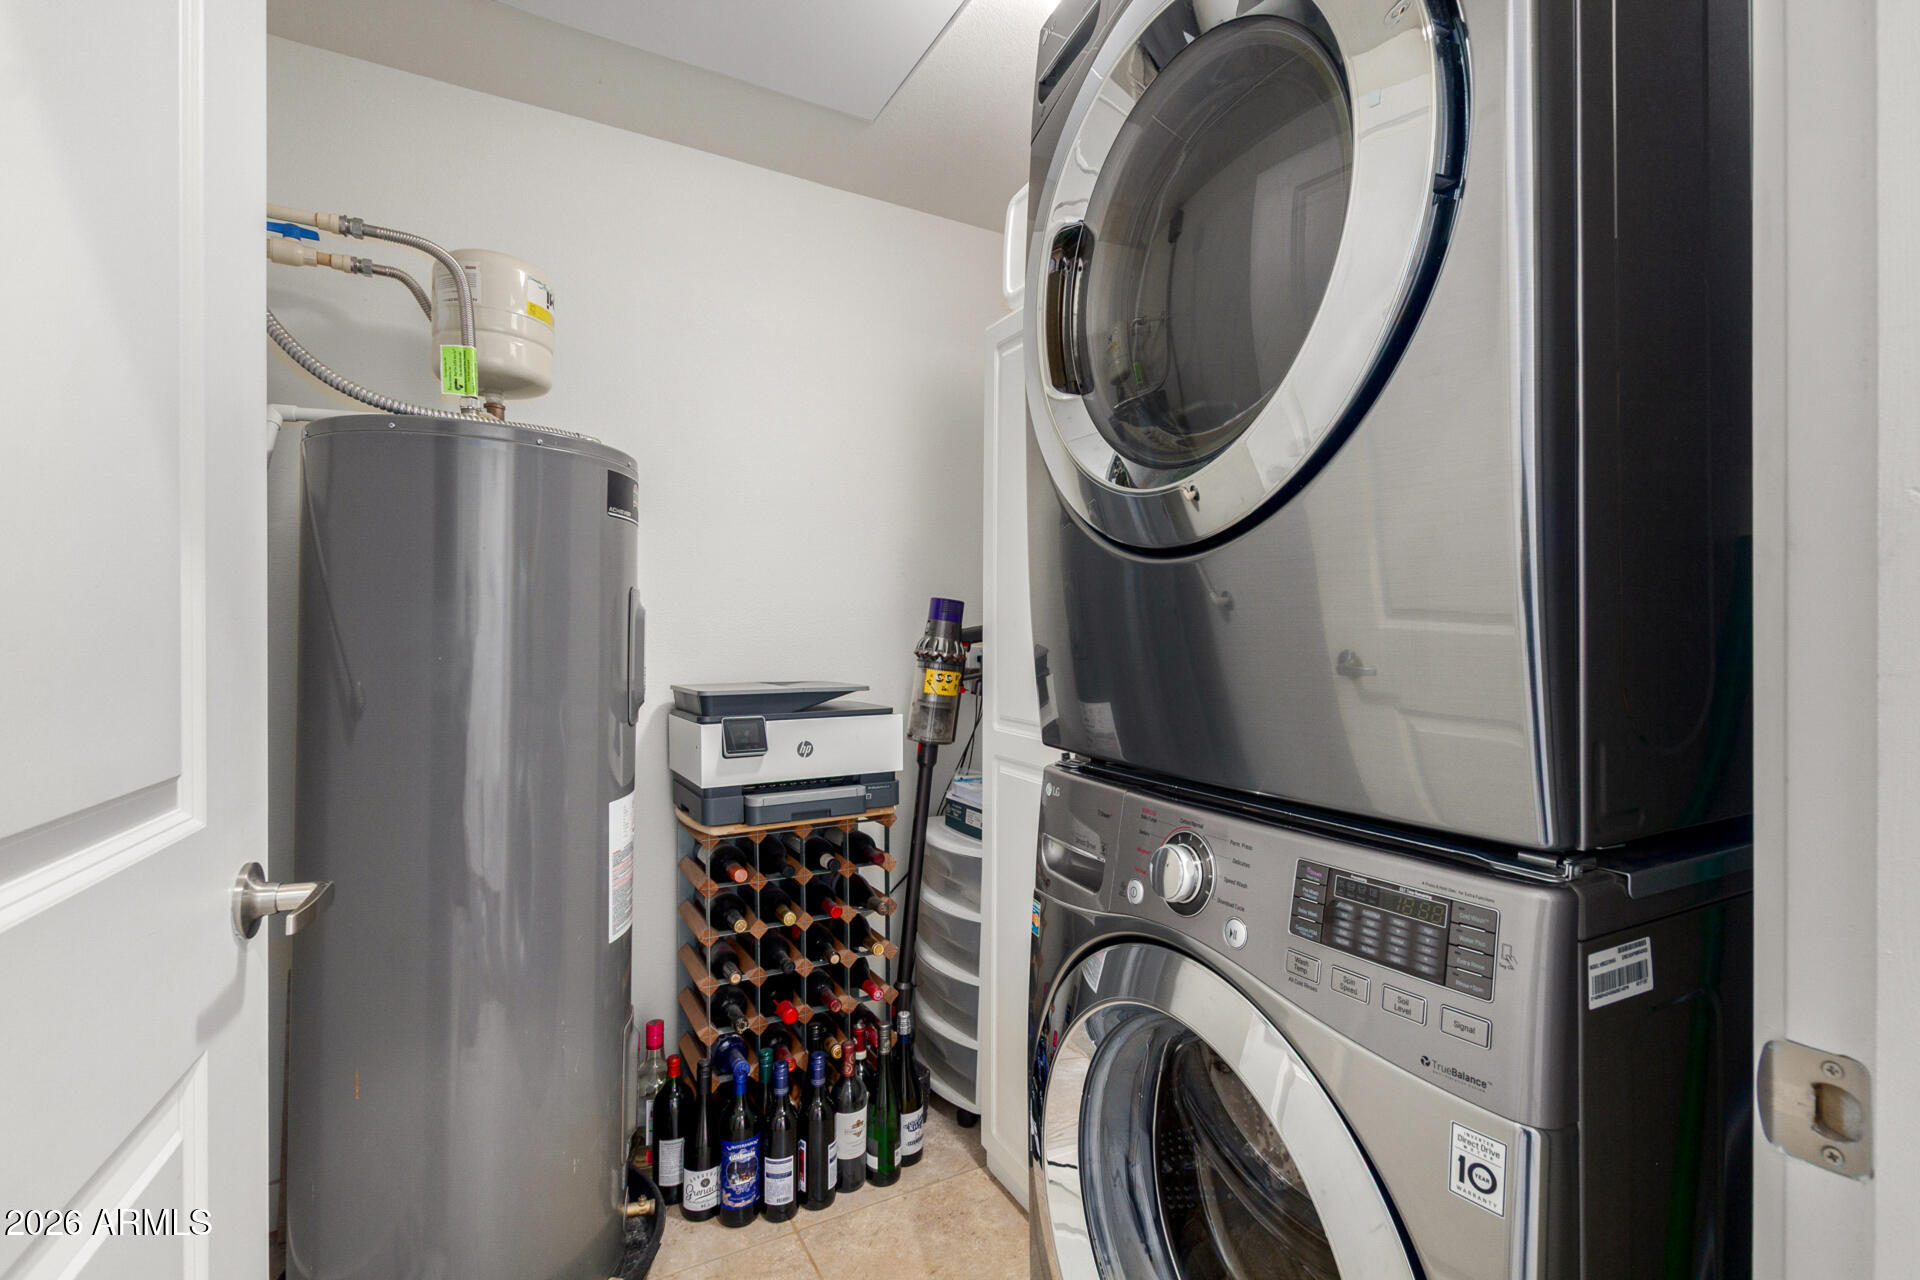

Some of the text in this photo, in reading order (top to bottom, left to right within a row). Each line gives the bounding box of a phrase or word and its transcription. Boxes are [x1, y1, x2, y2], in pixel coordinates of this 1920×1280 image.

[798, 741, 812, 758] hp
[1052, 785, 1061, 797] LG
[1294, 956, 1309, 967] Wash
[1342, 975, 1356, 986] Spin
[1340, 982, 1358, 995] Speed
[1397, 995, 1410, 1006] Soil
[1393, 1002, 1412, 1016] Level
[1453, 1019, 1476, 1035] Signal
[1456, 1133, 1501, 1160] Direct Drive
[1463, 1131, 1495, 1149] INVERTER
[1458, 1154, 1497, 1195] 10
[1474, 1171, 1491, 1185] YEAR
[1456, 1184, 1498, 1209] WARRANTY
